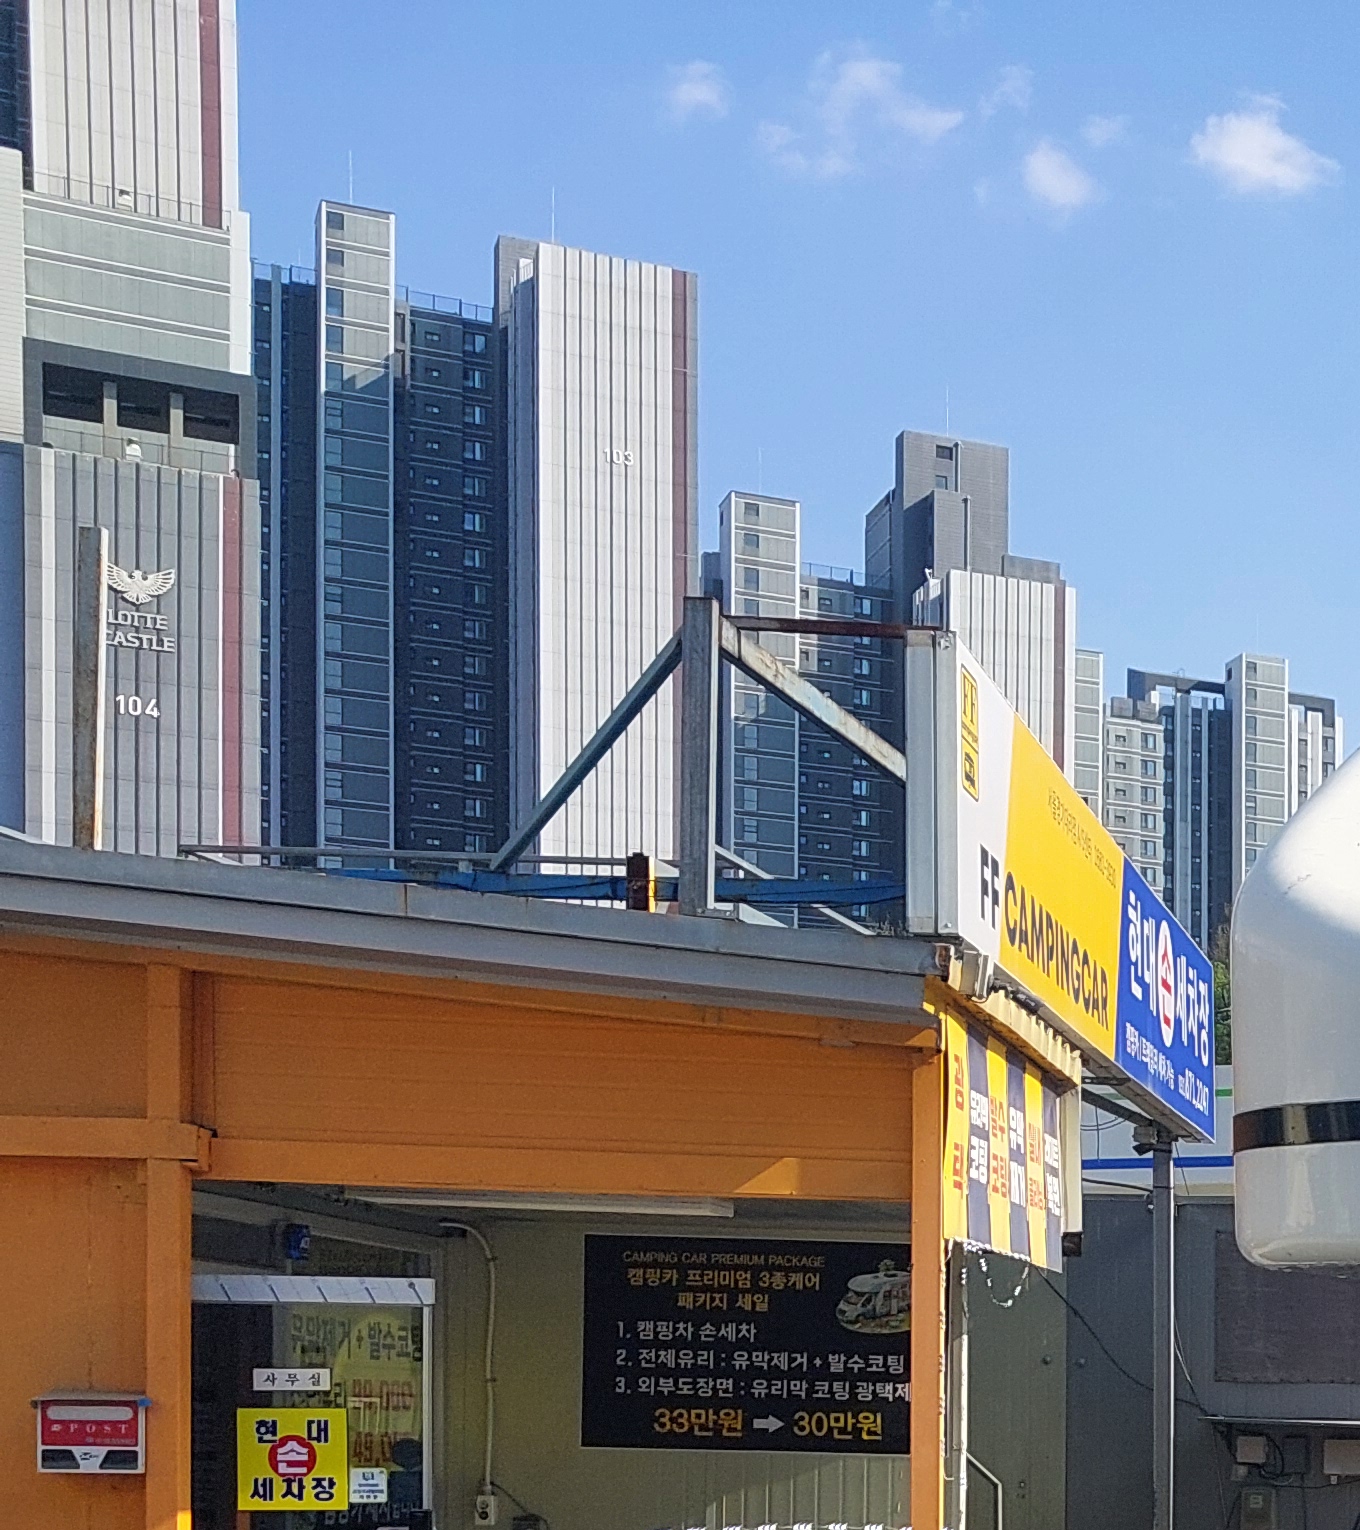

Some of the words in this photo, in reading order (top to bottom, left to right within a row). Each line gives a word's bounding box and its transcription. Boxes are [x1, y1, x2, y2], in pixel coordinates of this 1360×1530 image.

[603, 448, 633, 466] 103
[108, 608, 168, 630] LOTTE
[115, 694, 160, 719] 104
[980, 843, 1000, 930] FF
[1004, 871, 1110, 1031] CAMPINGCAR
[992, 1152, 1007, 1199] 코팅
[623, 1251, 679, 1265] CAMPING
[681, 1252, 708, 1265] CAR
[711, 1253, 765, 1267] PREMIUM
[768, 1255, 826, 1268] PACKAGE
[626, 1267, 679, 1287] 캠핑카
[685, 1268, 752, 1289] 프리미엄
[758, 1270, 821, 1292] 3종케어
[676, 1292, 728, 1311] 패키지
[735, 1293, 770, 1313] 세일
[616, 1320, 632, 1339] 1.
[637, 1319, 694, 1342] 캠핑차
[698, 1320, 757, 1344] 손세차
[615, 1348, 633, 1367] 2.
[637, 1348, 714, 1370] 전체유리
[730, 1352, 809, 1372] 유막제거
[828, 1353, 905, 1375] 발수코팅
[262, 1371, 322, 1388] 사무실
[614, 1376, 632, 1395] 3.
[637, 1376, 735, 1399] 외부도장면
[750, 1379, 809, 1400] 유리막
[812, 1380, 851, 1401] 코팅
[69, 1423, 129, 1435] POST
[254, 1418, 330, 1445] 현대
[653, 1407, 743, 1438] 33만원
[792, 1411, 883, 1441] 30만원
[276, 1439, 310, 1475] 손
[249, 1476, 337, 1503] 세차장
